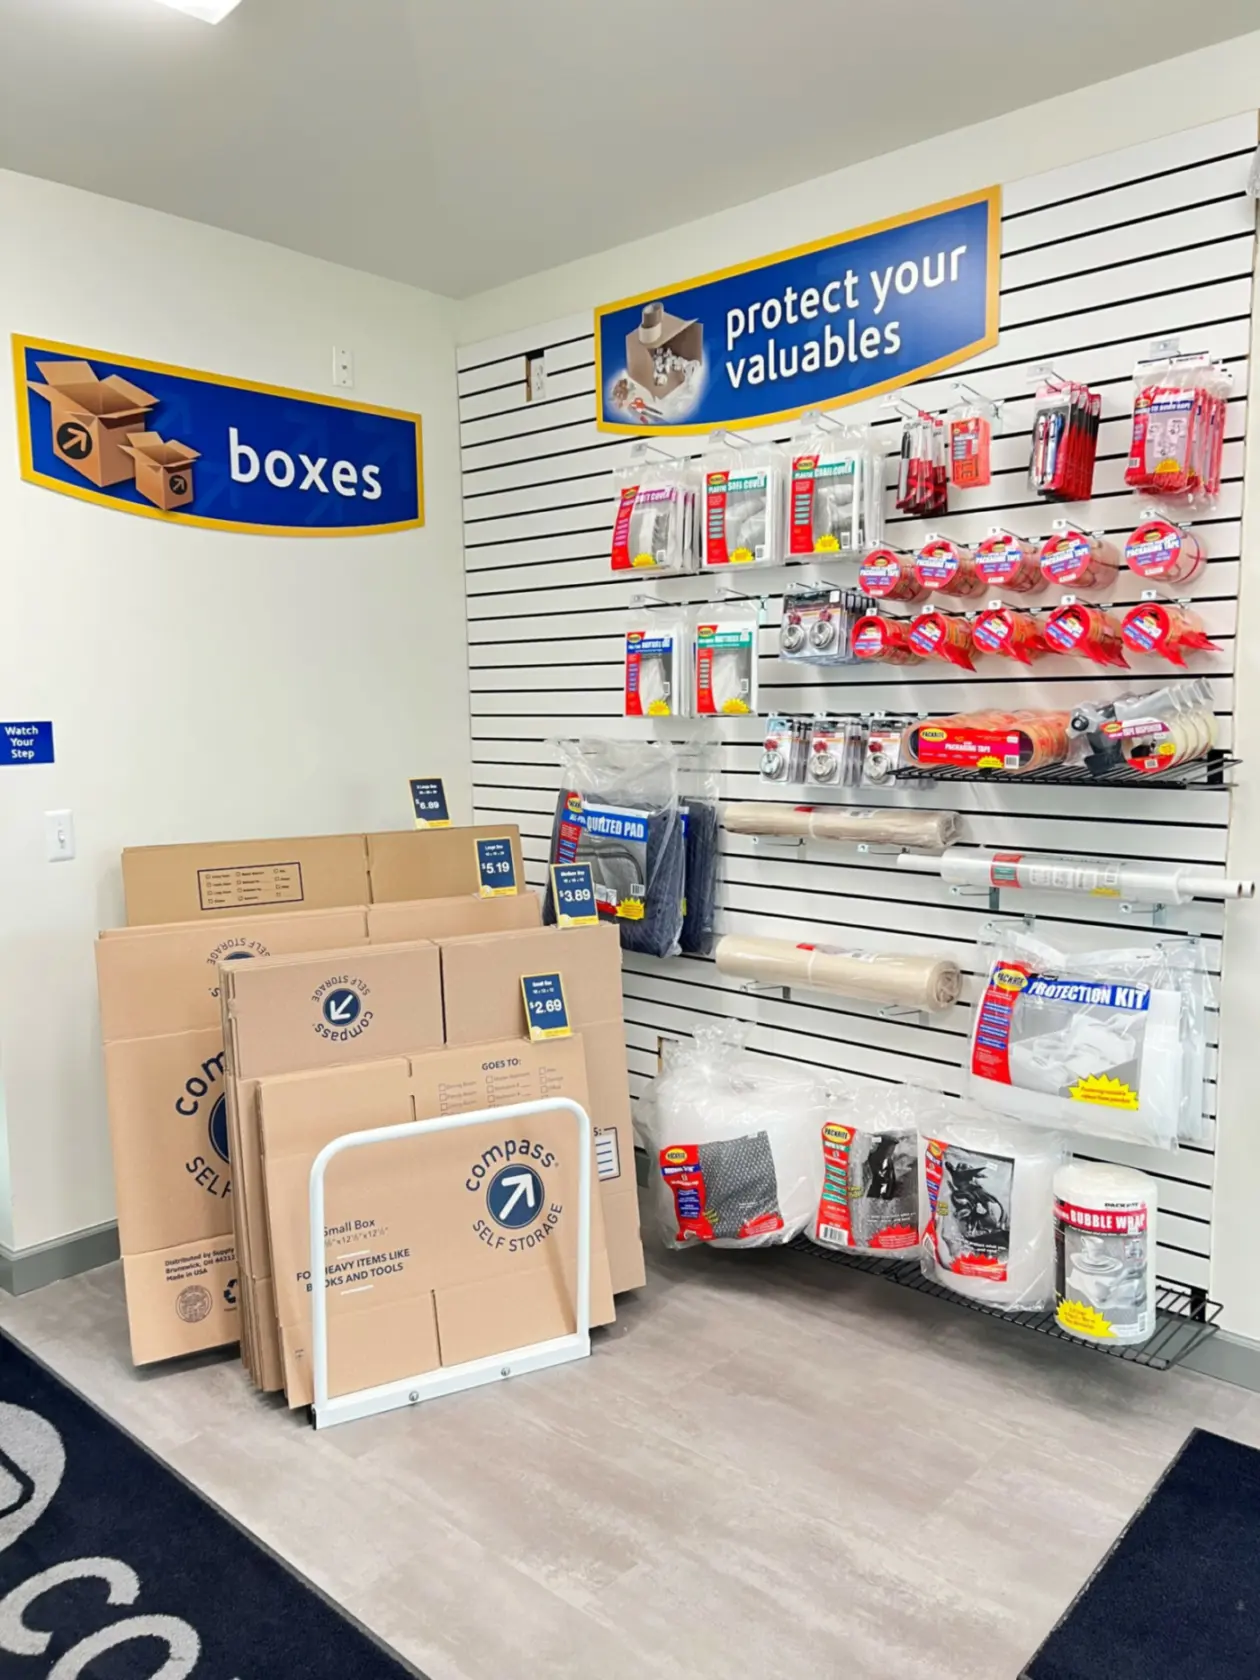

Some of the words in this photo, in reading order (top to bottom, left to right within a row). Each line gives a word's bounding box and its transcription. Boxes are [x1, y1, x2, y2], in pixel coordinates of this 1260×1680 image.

[727, 269, 859, 351] protect
[870, 245, 966, 315] your
[726, 321, 900, 388] valuables
[229, 427, 382, 500] boxes
[4, 725, 39, 736] Watch
[10, 738, 34, 747] Your
[11, 749, 35, 760] Step
[587, 816, 622, 835] QUILTED
[624, 821, 644, 838] PAD
[481, 861, 510, 874] $5.19
[559, 888, 591, 902] $3.89
[206, 938, 247, 966] STORAGE
[311, 975, 349, 1002] STORAGE
[350, 978, 371, 996] SELF
[1029, 981, 1110, 1005] PROTECTION
[1114, 987, 1147, 1009] KIT
[529, 998, 562, 1014] $2.69
[315, 1011, 374, 1041] compass
[481, 1060, 505, 1071] GOES
[507, 1058, 521, 1067] TO:
[466, 1139, 556, 1192] compass
[324, 1221, 351, 1237] Small
[354, 1219, 375, 1230] Box
[473, 1220, 506, 1249] SELF
[509, 1203, 562, 1252] STORAGE
[1070, 1209, 1112, 1229] BUBBLE
[1116, 1213, 1146, 1229] WRAP
[165, 1254, 201, 1267] Distributed
[296, 1271, 311, 1282] FO
[357, 1253, 387, 1268] ITEMS
[389, 1248, 411, 1260] LIKE
[194, 1268, 208, 1276] USA
[306, 1275, 343, 1292] BOKS
[346, 1270, 368, 1283] AND
[370, 1262, 404, 1277] TOOLS
[0, 1556, 201, 1680] co
